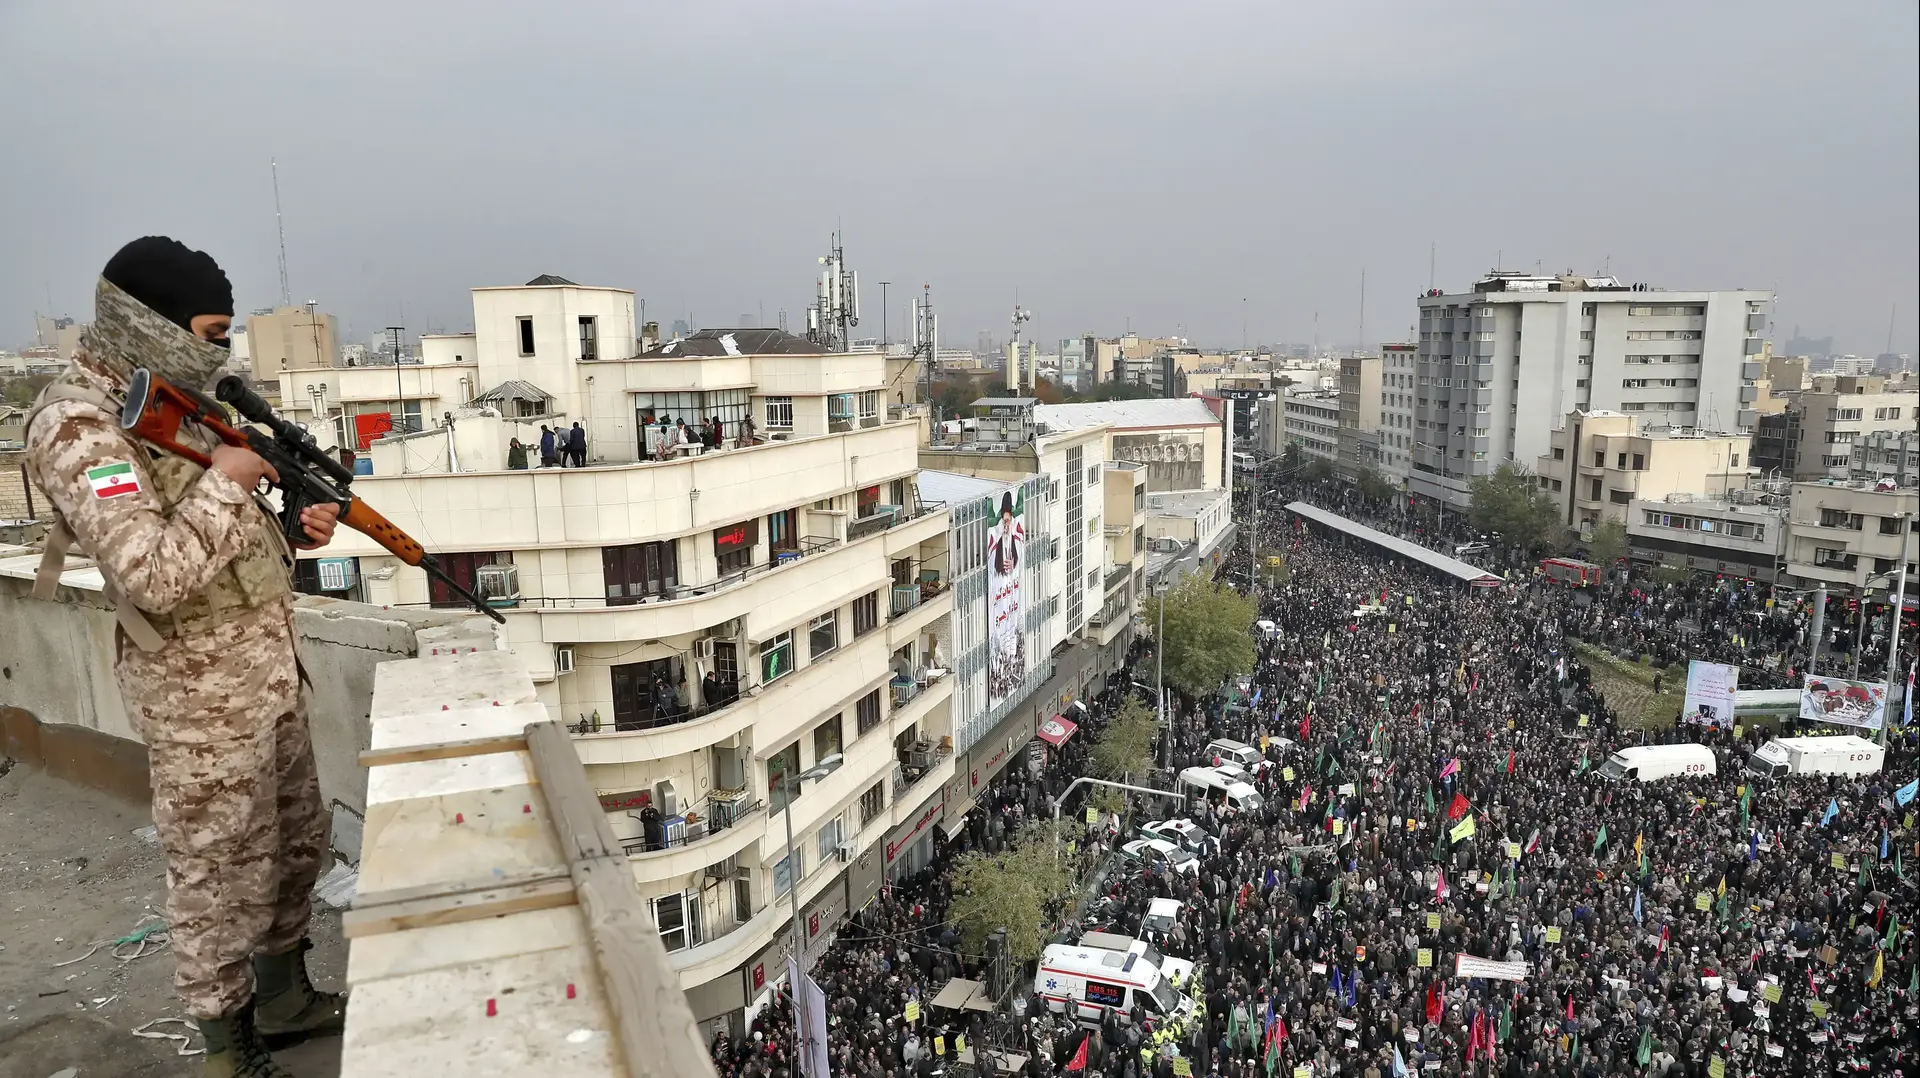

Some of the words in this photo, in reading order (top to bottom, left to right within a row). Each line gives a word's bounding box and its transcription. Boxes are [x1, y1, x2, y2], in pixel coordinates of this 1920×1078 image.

[1765, 744, 1779, 754] EOD
[1850, 753, 1871, 761] EOD
[1686, 763, 1706, 773] EOD
[1088, 984, 1105, 993] EMS
[1107, 988, 1118, 996] 115
